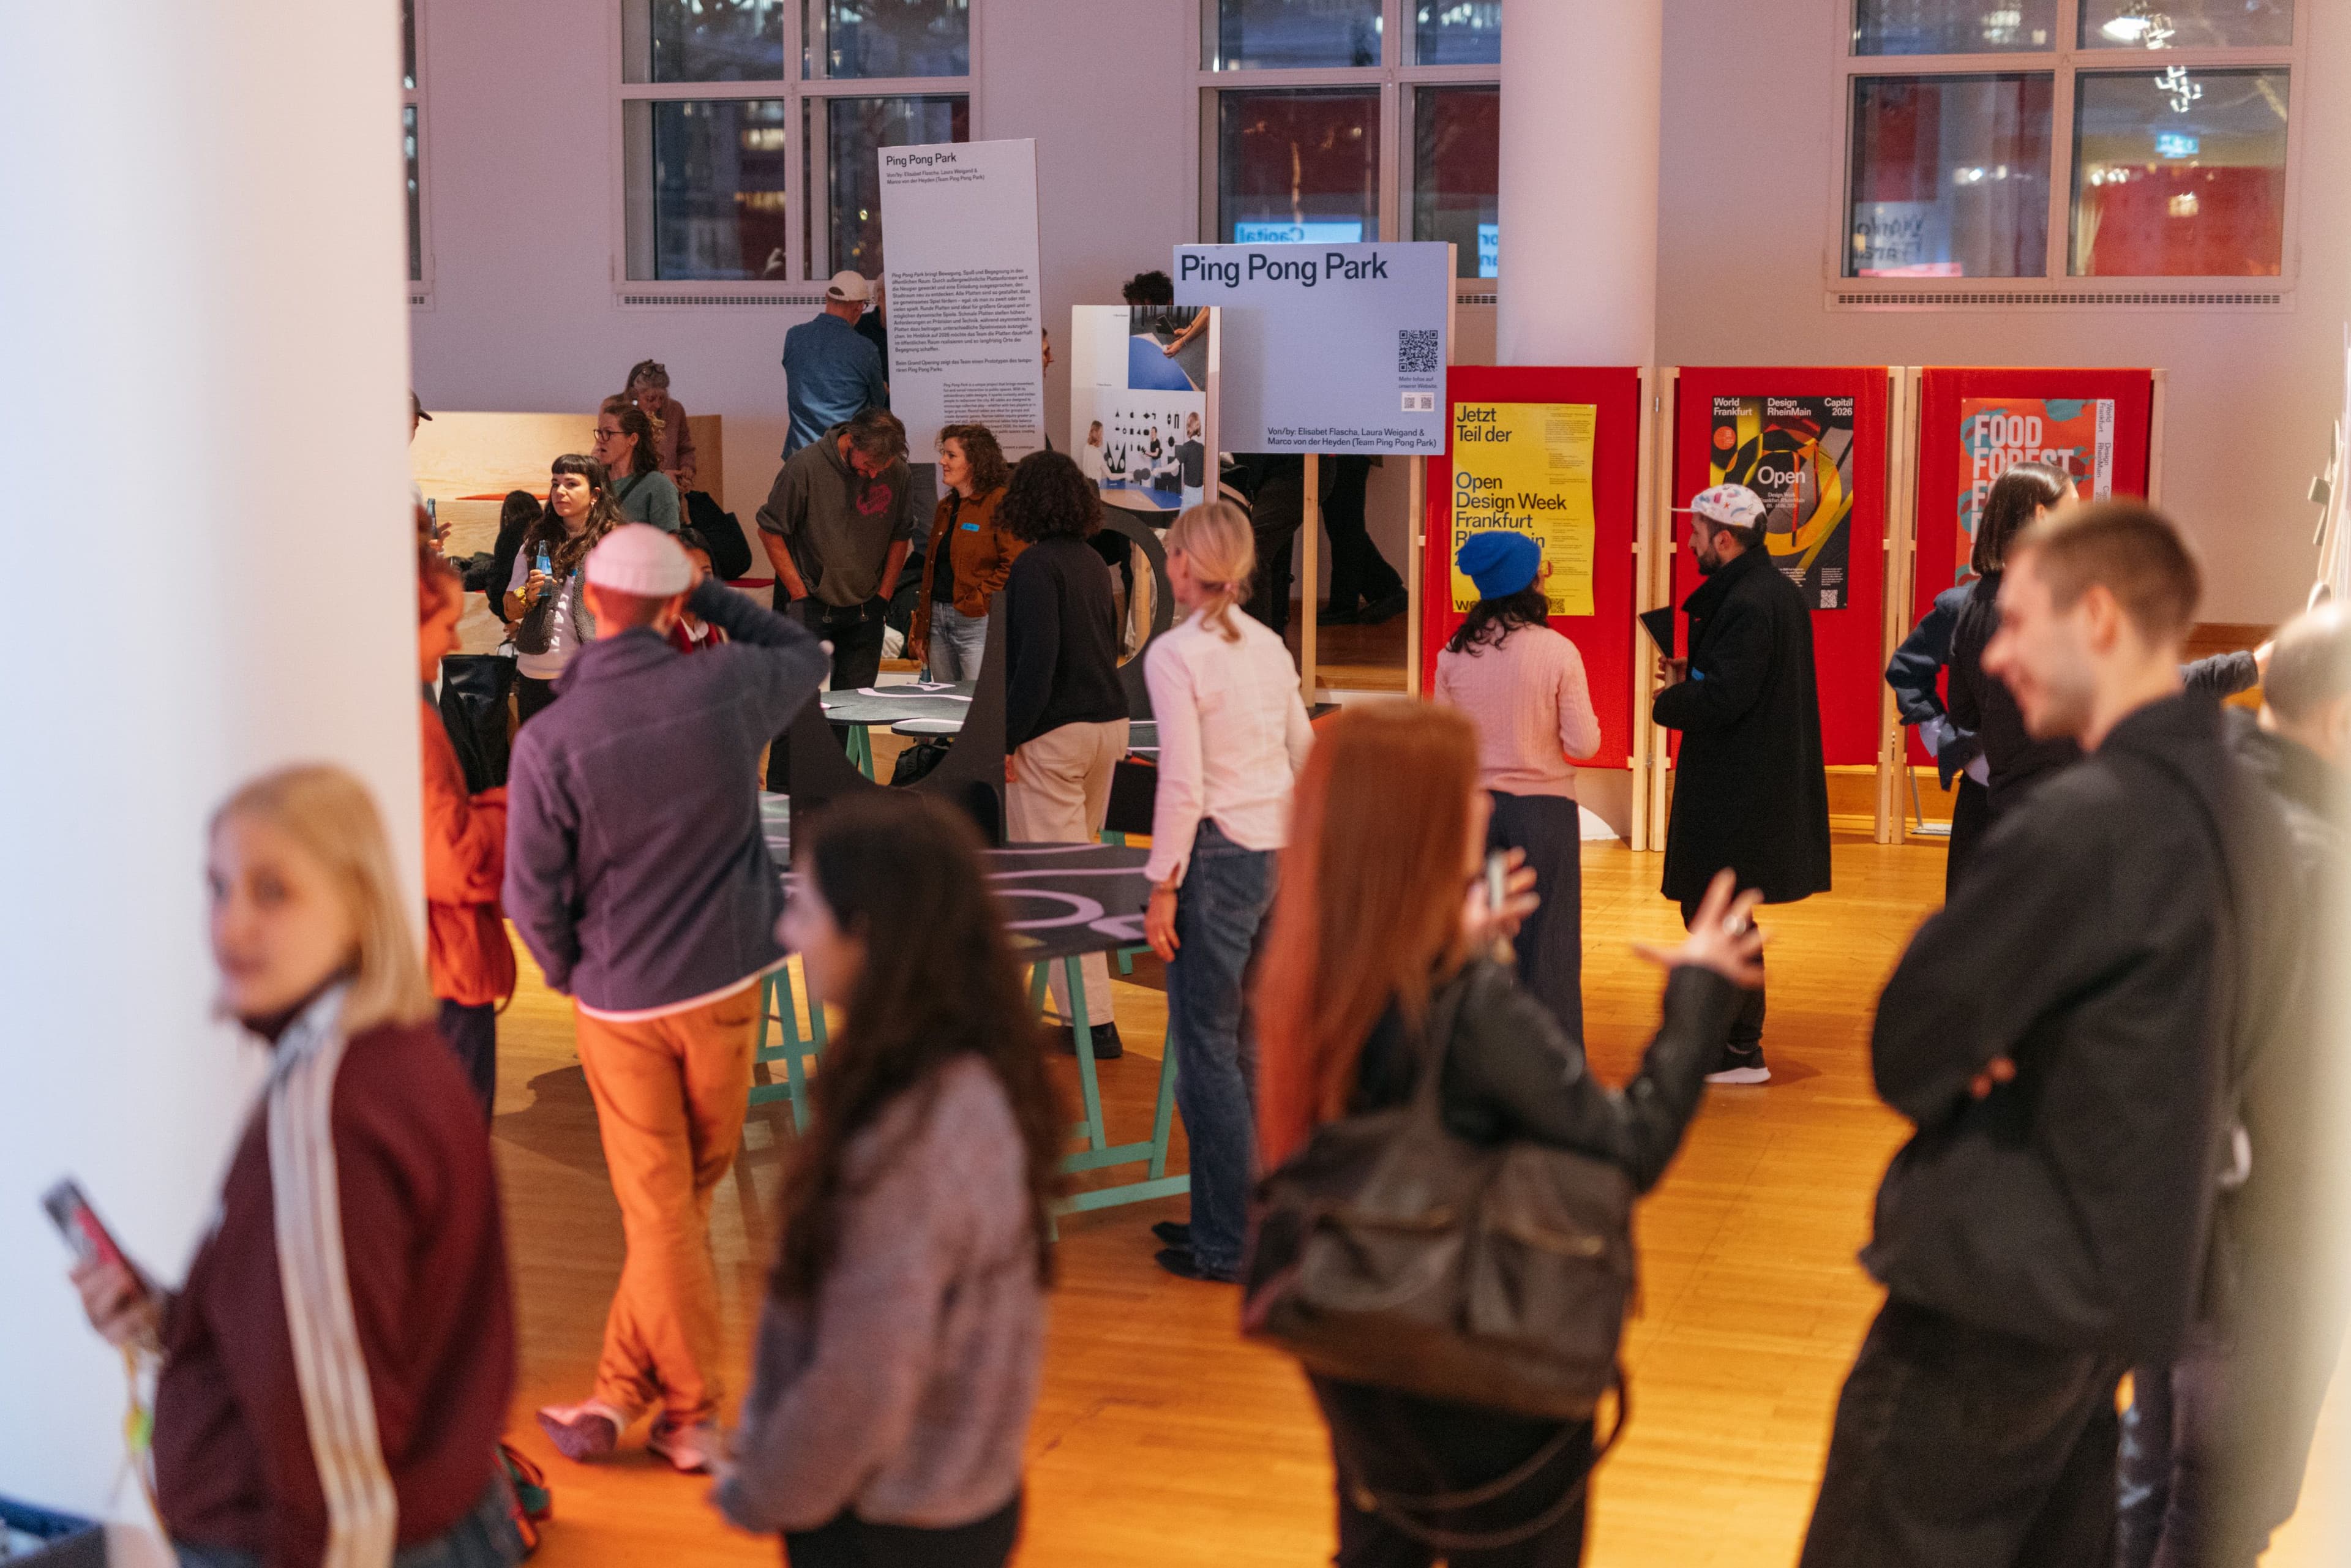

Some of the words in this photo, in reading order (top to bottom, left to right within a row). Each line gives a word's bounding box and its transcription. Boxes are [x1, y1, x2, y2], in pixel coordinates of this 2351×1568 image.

[887, 156, 907, 167] Ping
[909, 154, 932, 166] Pong
[936, 152, 956, 162] Park
[1181, 254, 1240, 288] Ping
[1248, 253, 1317, 287] Pong
[1326, 252, 1388, 279] Park
[1714, 398, 1739, 407] World
[1768, 398, 1797, 409] Design
[1824, 398, 1853, 409] Capital
[1768, 408, 1811, 416] RheinMain
[1457, 405, 1496, 422] Jetzt
[1268, 427, 1295, 437] Von/by:
[1384, 429, 1417, 438] Weigand
[1457, 425, 1481, 441] Teil
[1485, 425, 1512, 442] der
[1974, 415, 2042, 448] FOOD
[1322, 438, 1351, 447] Heyden
[1352, 438, 1374, 447] (Team
[1376, 438, 1393, 448] Ping
[1395, 438, 1414, 448] Pong
[1456, 472, 1502, 492] Open
[1758, 466, 1805, 488] Open
[1456, 492, 1515, 512] Design
[1518, 493, 1567, 510] Week
[1456, 512, 1532, 528] Frankfurt
